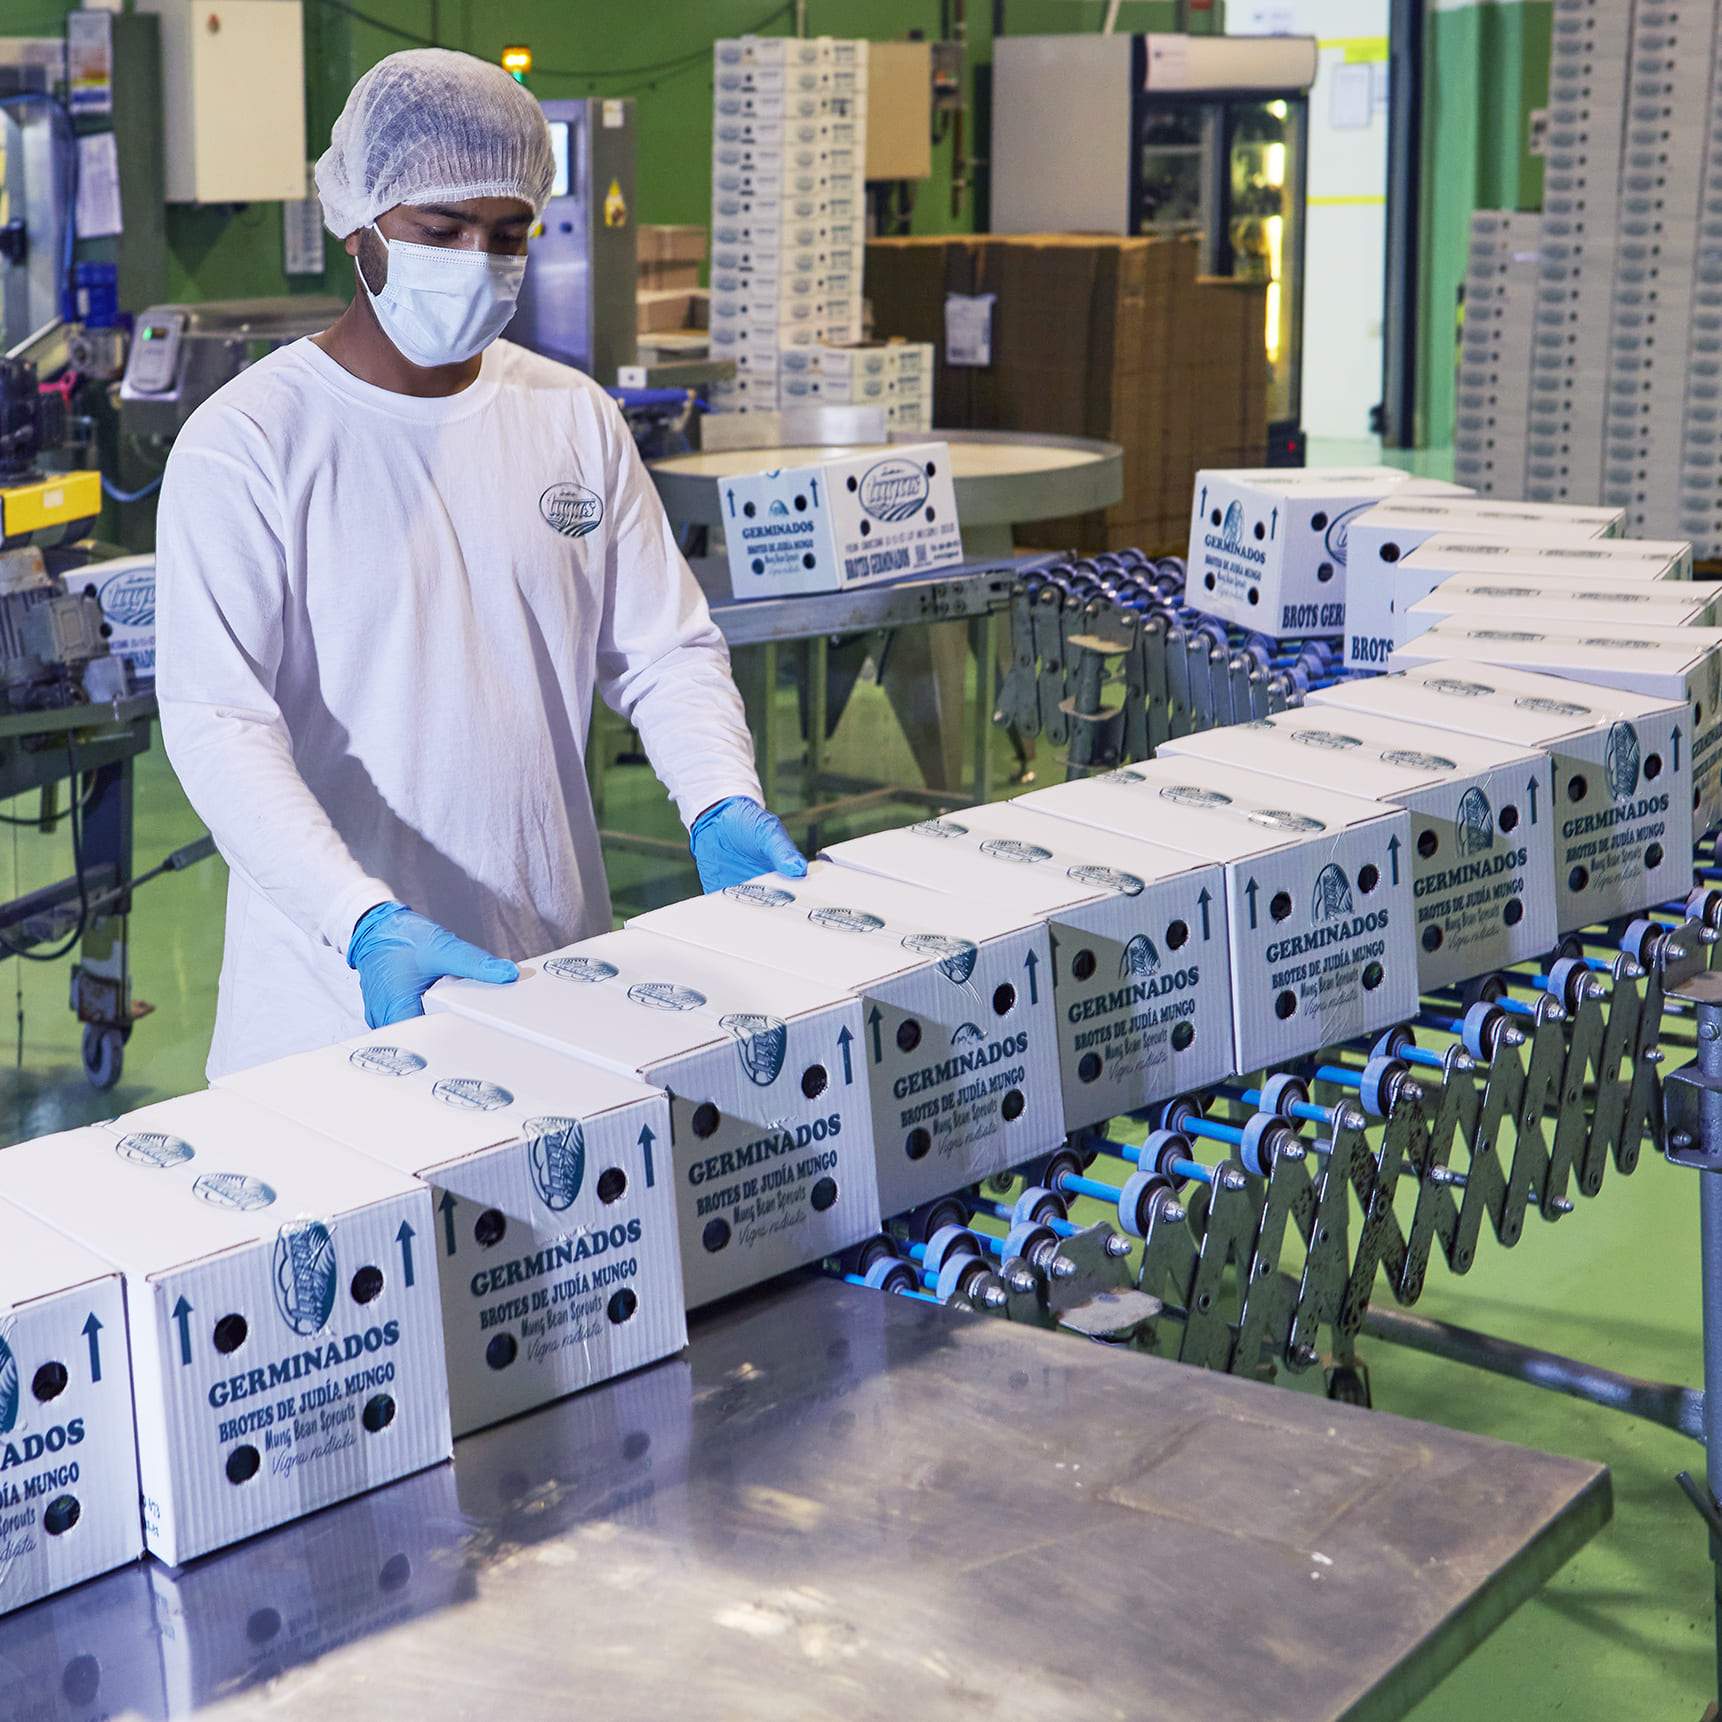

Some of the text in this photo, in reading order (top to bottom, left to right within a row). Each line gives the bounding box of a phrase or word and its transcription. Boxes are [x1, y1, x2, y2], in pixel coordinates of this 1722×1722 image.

[742, 520, 814, 539] GERMINADOS
[1205, 534, 1266, 564] GERMINADOS
[1282, 604, 1319, 628] BROTS
[1563, 793, 1669, 839] GERMINADOS
[1413, 847, 1527, 897] GERMINADOS
[1266, 908, 1388, 963] GERMINADOS
[1272, 940, 1384, 989] BROTES DE JUDÍA MUNGO
[1068, 965, 1199, 1023] GERMINADOS
[1075, 998, 1195, 1051] BROTES DE JUDÍA MUNGO
[893, 1031, 1028, 1099] GERMINADOS
[901, 1066, 1024, 1128] BROTES DE JUDÍA MUNGO
[689, 1113, 841, 1186] GERMINADOS
[697, 1150, 837, 1217] BROTES DE JUDÍA MUNGO
[471, 1218, 642, 1296] GERMINADOS
[480, 1257, 637, 1330] BROTES DE JUDÍA MUNGO
[521, 1296, 602, 1338] Mung Bean Sprouts
[209, 1320, 400, 1409] GERMINADOS
[528, 1337, 560, 1364] Vigna
[219, 1361, 395, 1443] BROTES DE JUDÍA MUNGO
[265, 1404, 355, 1452] Mung Bean Sprouts
[23, 1461, 80, 1500] MUNGO
[272, 1451, 308, 1478] Vigna
[0, 1507, 35, 1541] prouts
